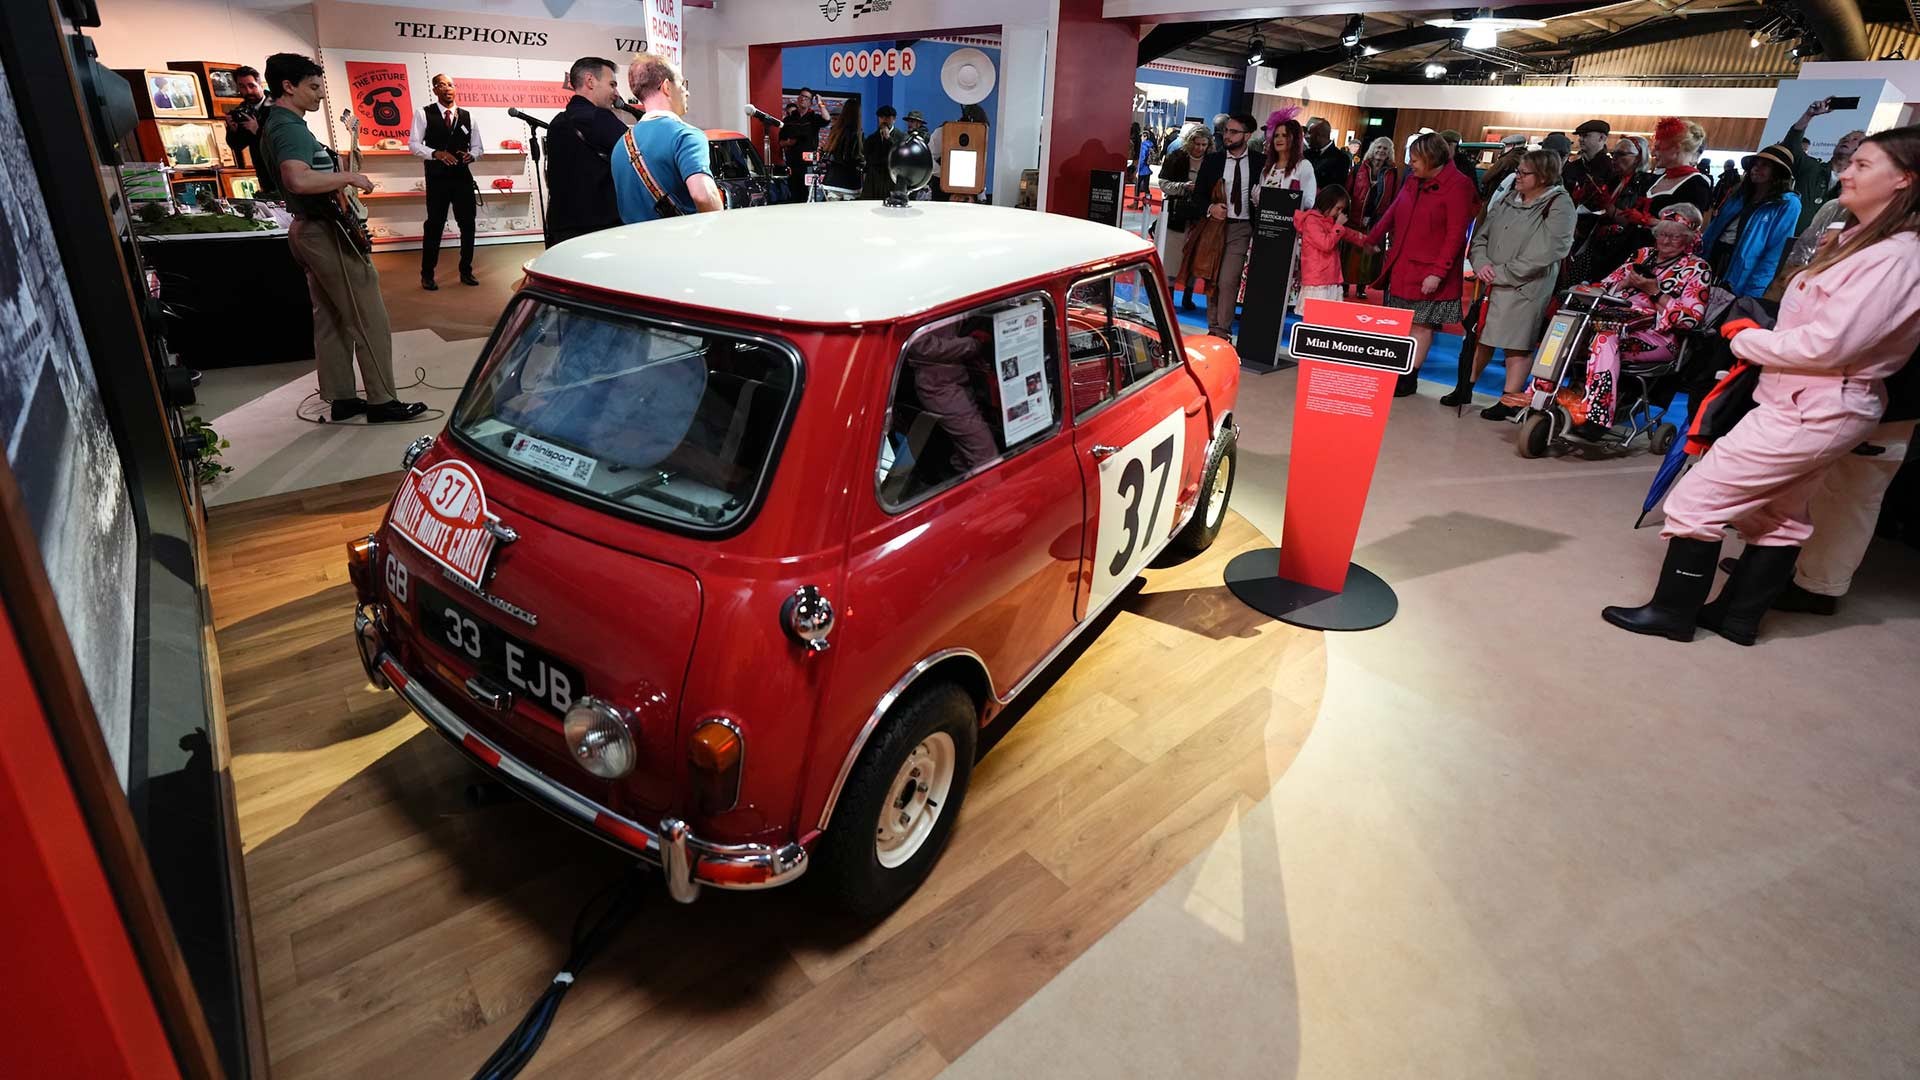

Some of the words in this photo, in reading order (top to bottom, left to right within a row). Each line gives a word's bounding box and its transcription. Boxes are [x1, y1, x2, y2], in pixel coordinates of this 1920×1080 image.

[395, 21, 549, 47] TELEPHONES
[652, 17, 679, 42] RACING
[615, 38, 648, 53] VID
[832, 52, 912, 73] COOPER
[352, 79, 371, 89] THE
[371, 72, 406, 84] FUTURE
[456, 92, 479, 102] THE
[481, 94, 509, 103] TALK
[512, 95, 525, 103] OF
[528, 95, 551, 104] THE
[552, 95, 571, 104] TOW
[360, 127, 369, 135] IS
[371, 129, 411, 138] CALLING
[1305, 337, 1330, 349] Mini
[1331, 341, 1364, 354] Monte
[1366, 346, 1397, 359] Carlo.
[530, 443, 574, 465] minisport
[436, 474, 466, 510] 37
[1109, 434, 1174, 576] 37
[394, 476, 425, 535] RALLYE
[415, 510, 453, 556] MONTE
[447, 527, 496, 577] CARLO
[385, 553, 408, 603] GB
[444, 608, 481, 659] 33
[505, 641, 572, 714] EJB
